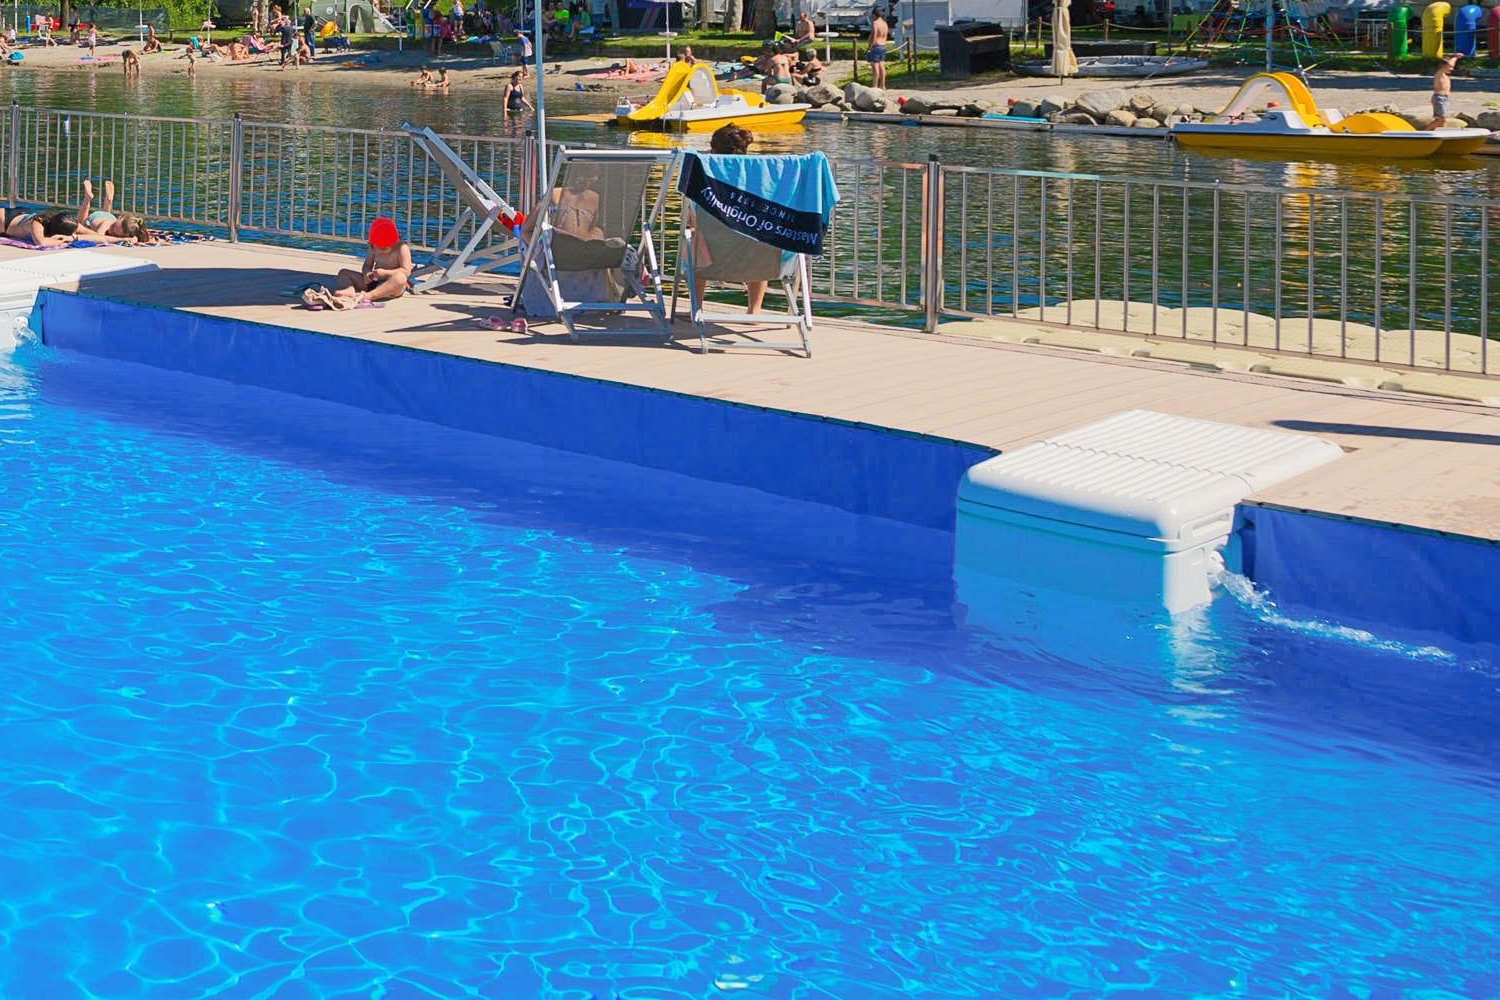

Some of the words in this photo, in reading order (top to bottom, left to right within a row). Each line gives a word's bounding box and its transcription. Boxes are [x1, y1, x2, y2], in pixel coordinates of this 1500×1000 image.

[700, 186, 758, 228] Originality
[756, 220, 773, 231] of
[775, 225, 818, 245] Masters
